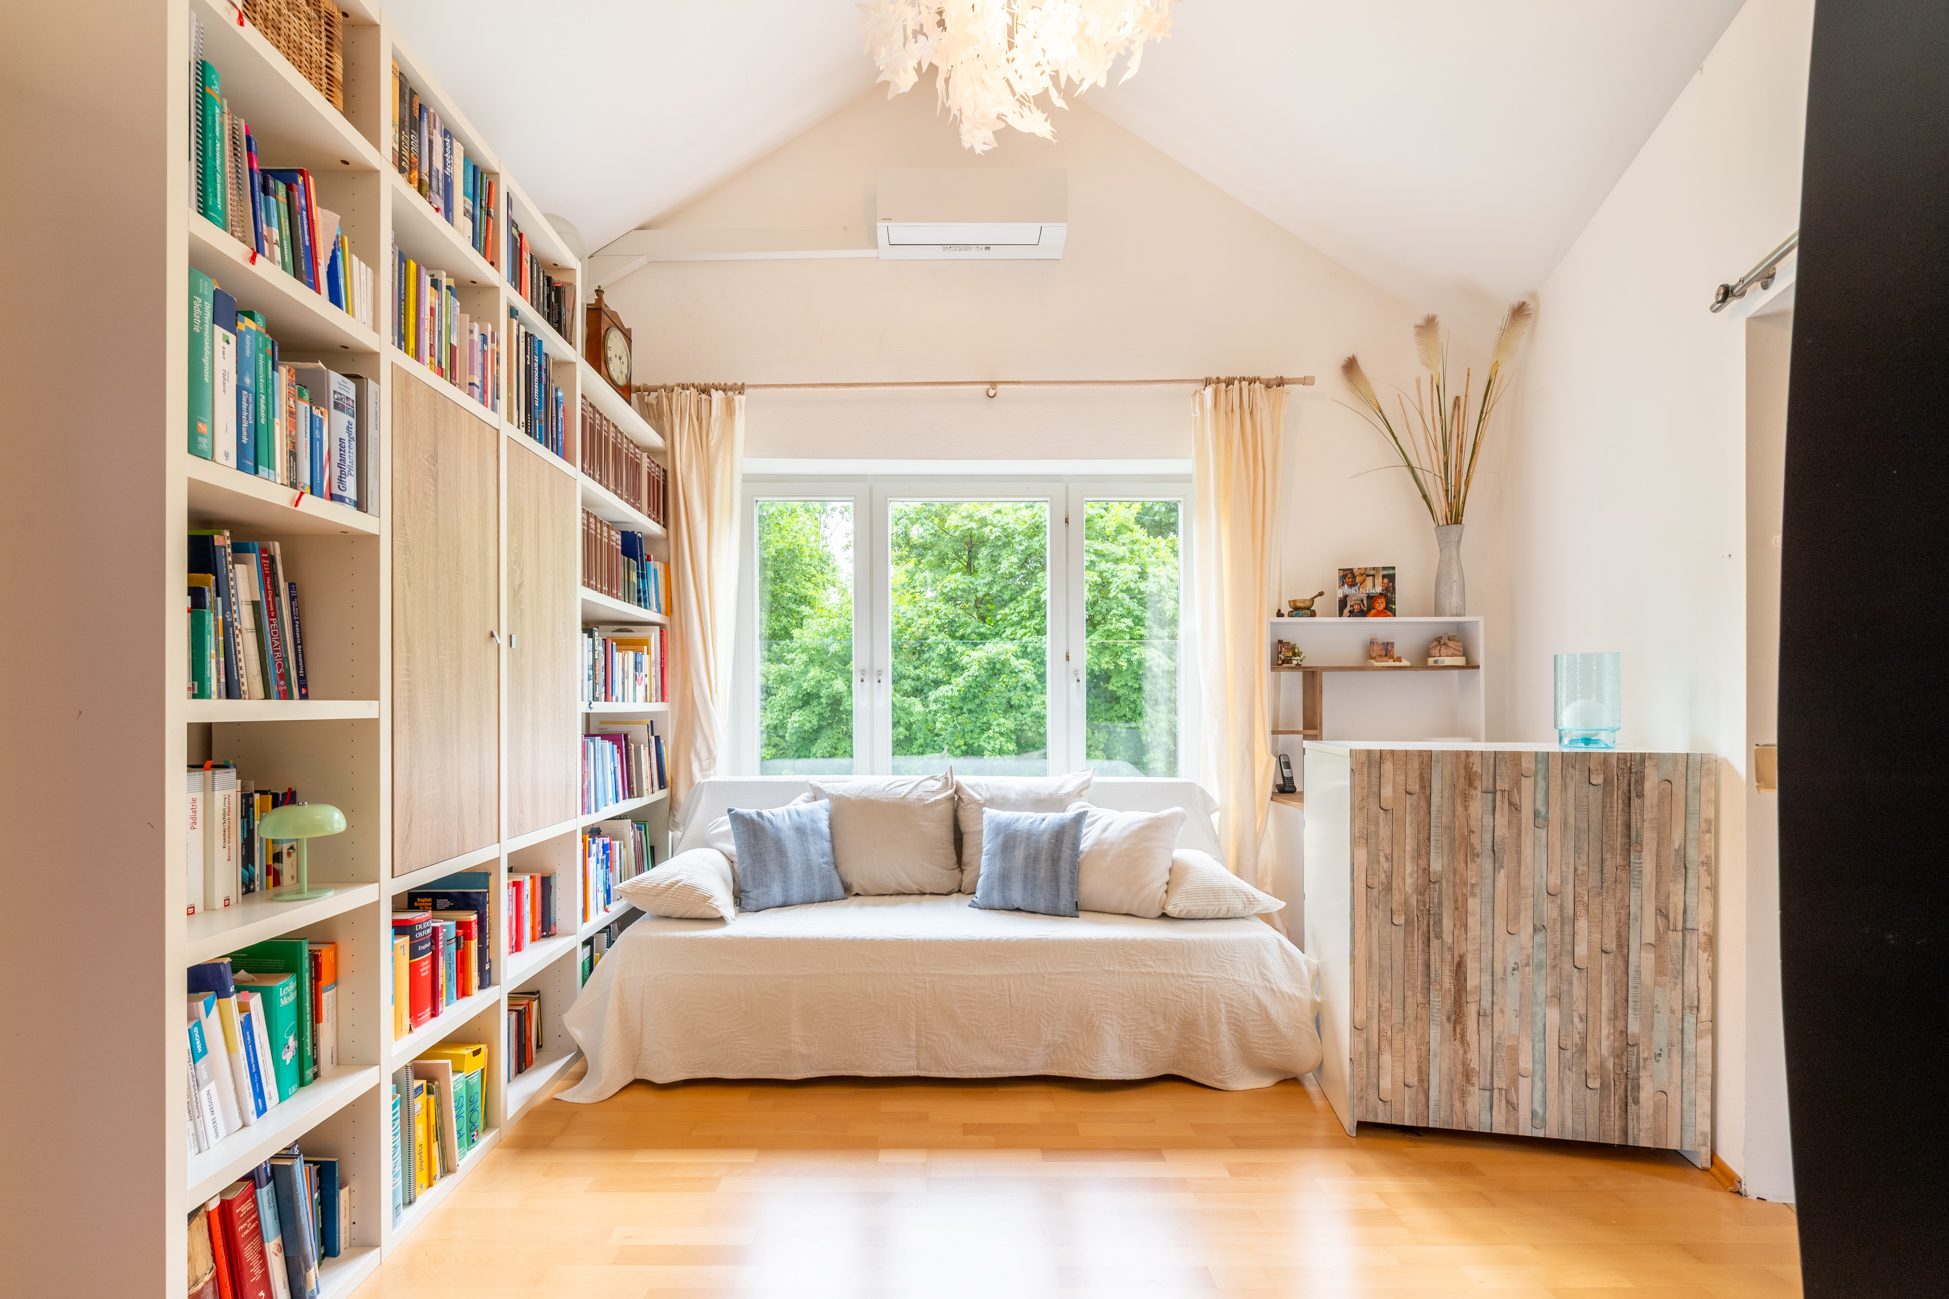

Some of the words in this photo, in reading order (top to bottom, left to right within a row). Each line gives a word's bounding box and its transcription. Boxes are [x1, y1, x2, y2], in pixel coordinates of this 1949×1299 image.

[193, 295, 203, 333] Pädiatrie
[203, 301, 212, 383] Differenzialdiagnose
[258, 352, 266, 393] Intensivkurs
[241, 390, 249, 445] Kinderheilkunde
[337, 437, 348, 493] Giftpflanzen
[346, 420, 356, 478] Pflanzengifte
[270, 618, 285, 674] PEDIATRICS
[189, 797, 198, 831] Pädiatrie
[193, 1026, 204, 1054] HEROLD
[468, 1091, 481, 1134] PONS
